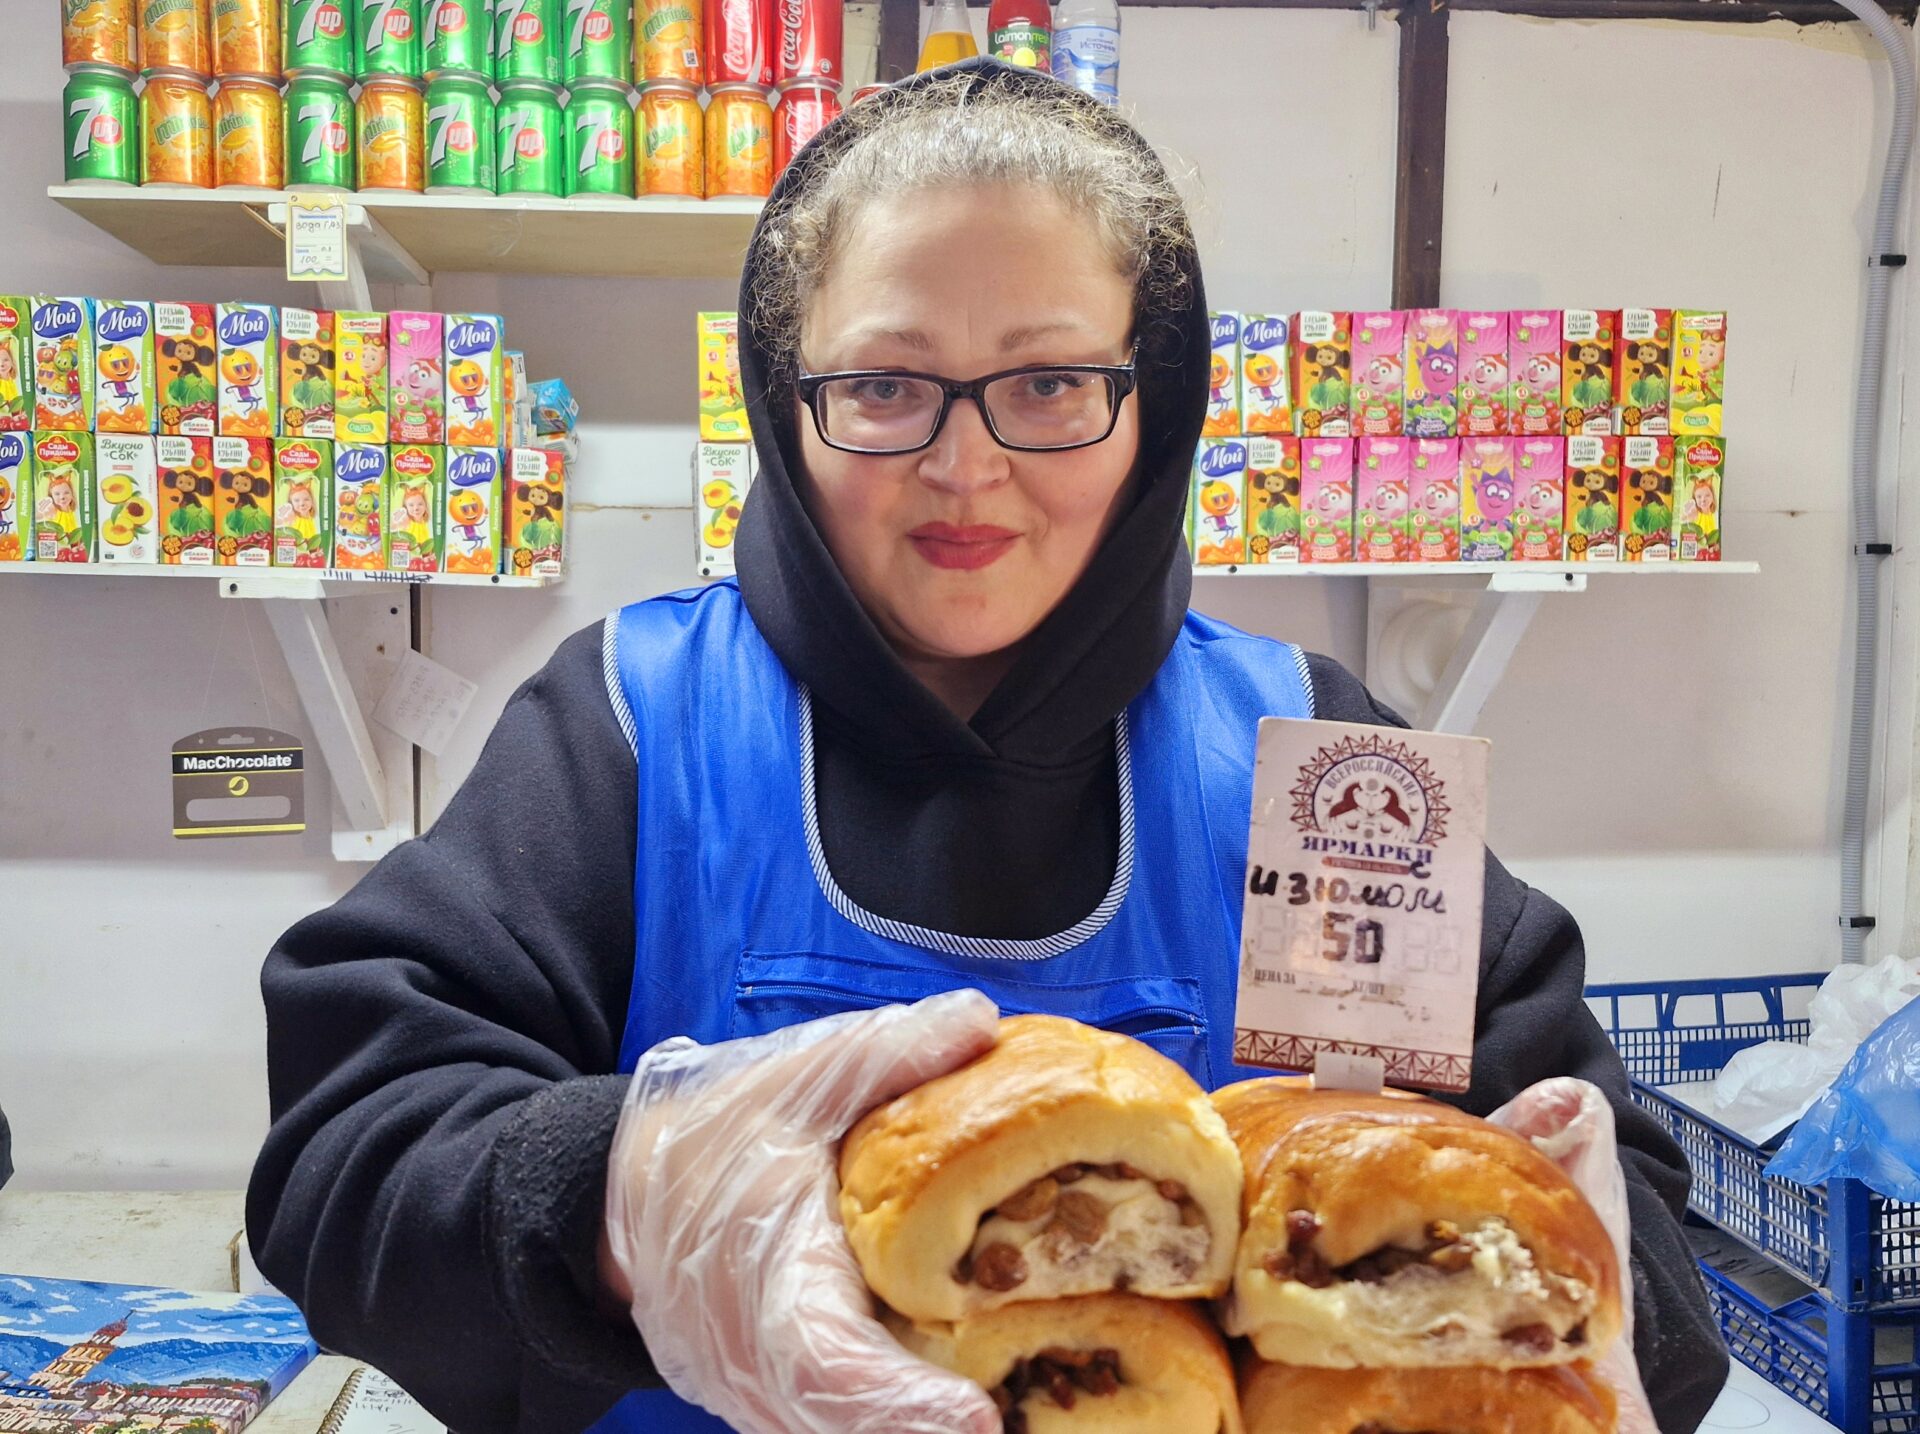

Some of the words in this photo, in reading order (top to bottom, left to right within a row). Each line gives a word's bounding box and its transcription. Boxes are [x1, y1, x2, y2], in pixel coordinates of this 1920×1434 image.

[34, 305, 76, 331] Мой
[99, 310, 142, 335] Мой
[221, 314, 264, 339] Мой
[450, 325, 491, 349] Мой
[1244, 322, 1283, 345] Мой
[0, 442, 18, 457] ой
[39, 448, 77, 457] Придонья
[48, 442, 69, 451] Сады
[100, 438, 144, 453] Вкусно
[702, 446, 741, 459] Вкусно
[337, 451, 380, 476] Мой
[451, 457, 491, 480] Мой
[1202, 447, 1244, 472] Мой
[183, 753, 293, 771] MacChocolate
[1324, 758, 1419, 799] ВСЕРОССИЙСКИЕ
[1301, 835, 1434, 865] ЯРМАРКИ
[1322, 910, 1384, 964] 50
[1254, 968, 1281, 984] ЦЕНА
[1283, 971, 1296, 985] ЗА
